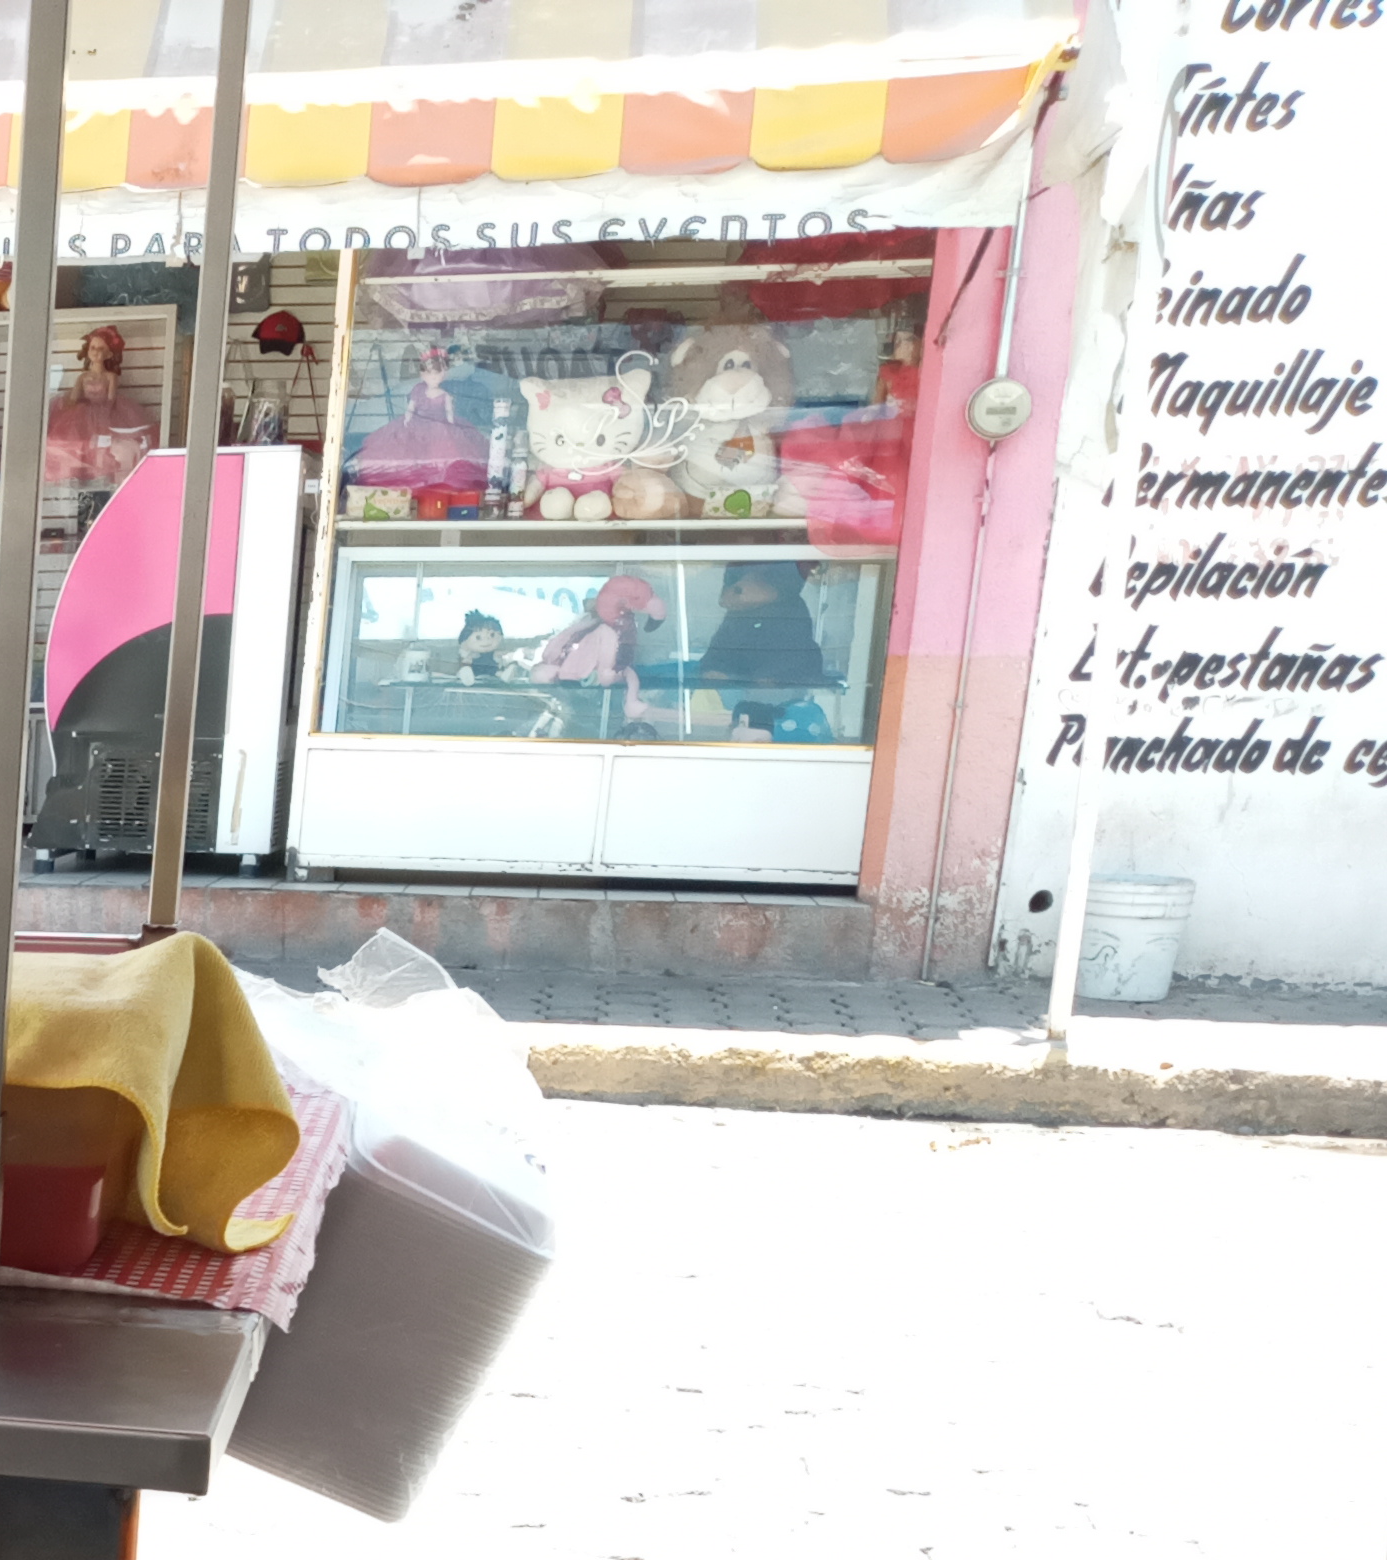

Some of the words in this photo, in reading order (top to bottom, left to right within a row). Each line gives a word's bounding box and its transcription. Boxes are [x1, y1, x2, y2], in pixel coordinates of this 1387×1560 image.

[1168, 162, 1267, 234] ñas
[110, 232, 241, 258] PAR
[1154, 252, 1312, 327] einado
[1101, 441, 1387, 511] ermanente
[1046, 714, 1272, 775] Pnchado
[1273, 715, 1331, 776] de
